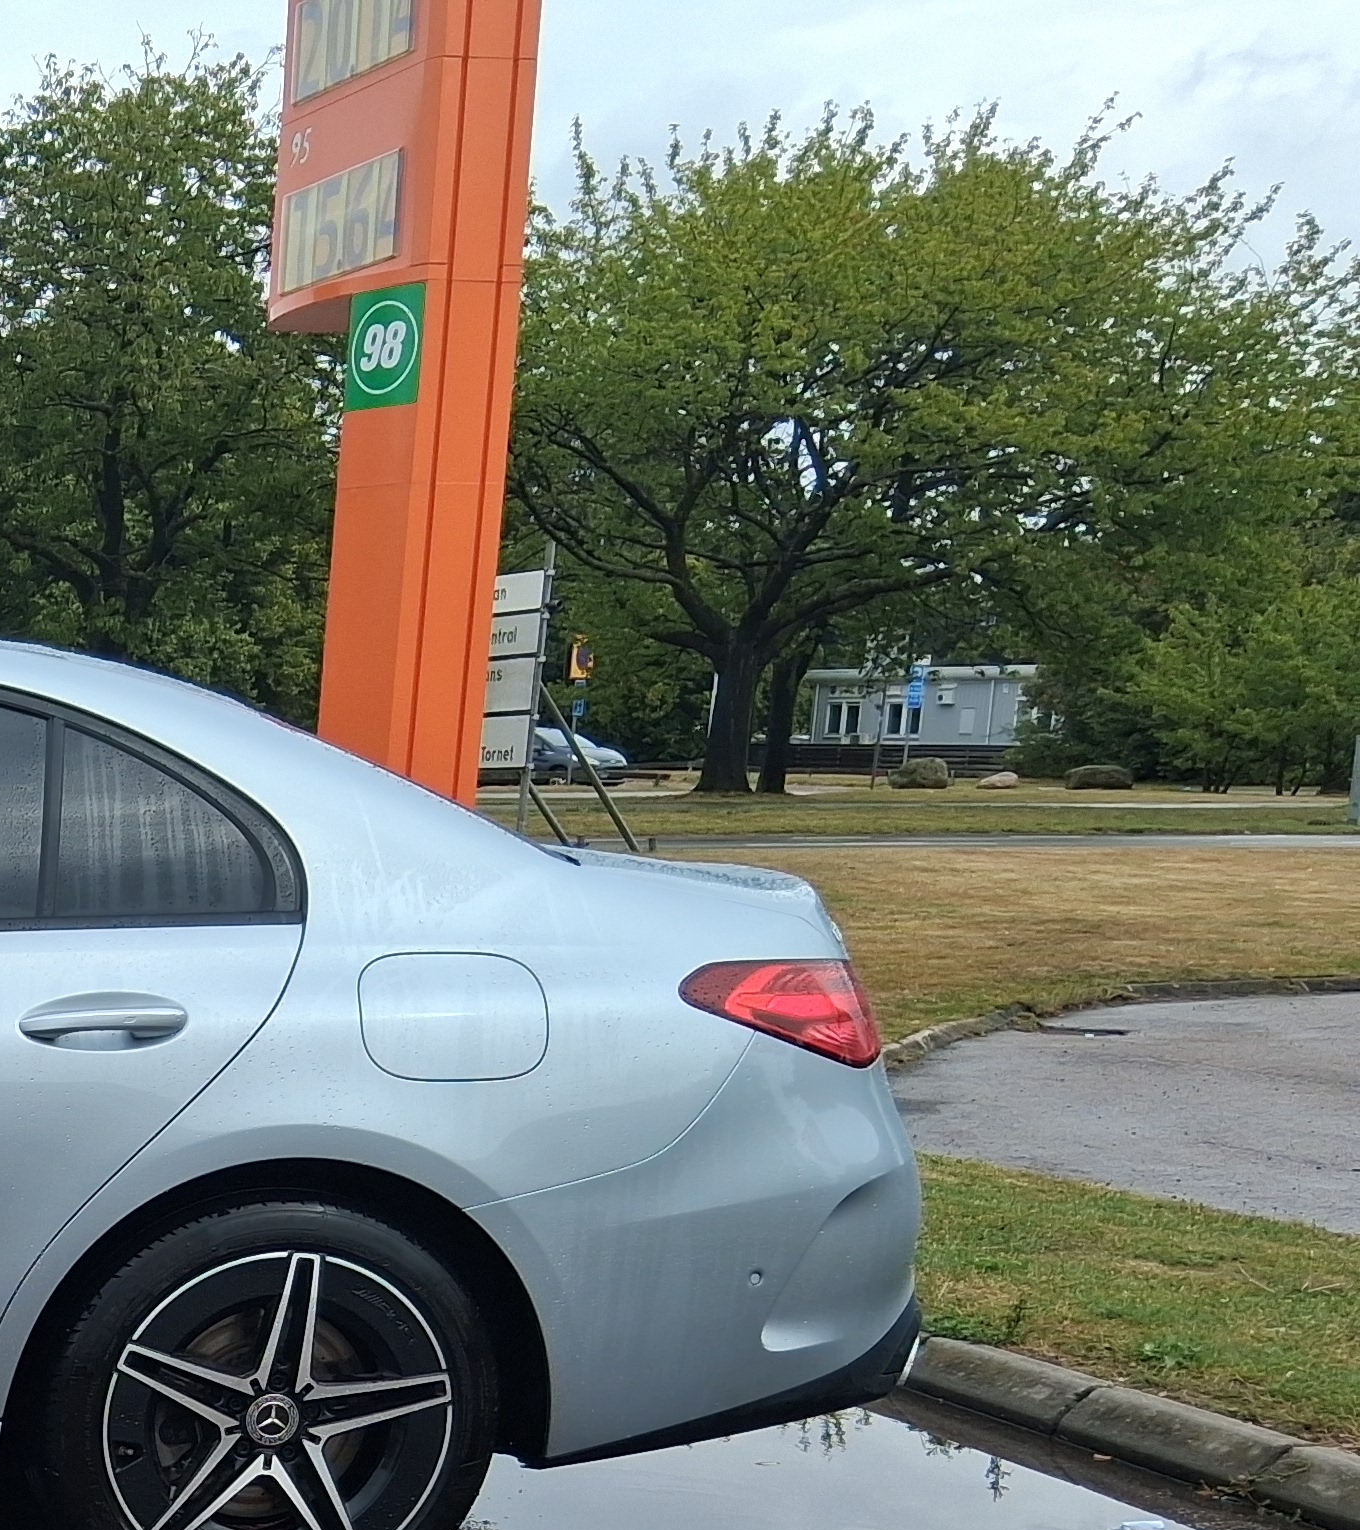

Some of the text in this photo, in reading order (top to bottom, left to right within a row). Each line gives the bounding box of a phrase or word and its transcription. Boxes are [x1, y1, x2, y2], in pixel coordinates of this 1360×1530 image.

[290, 126, 312, 168] 95
[360, 320, 407, 372] 98
[481, 745, 514, 763] Tornet
